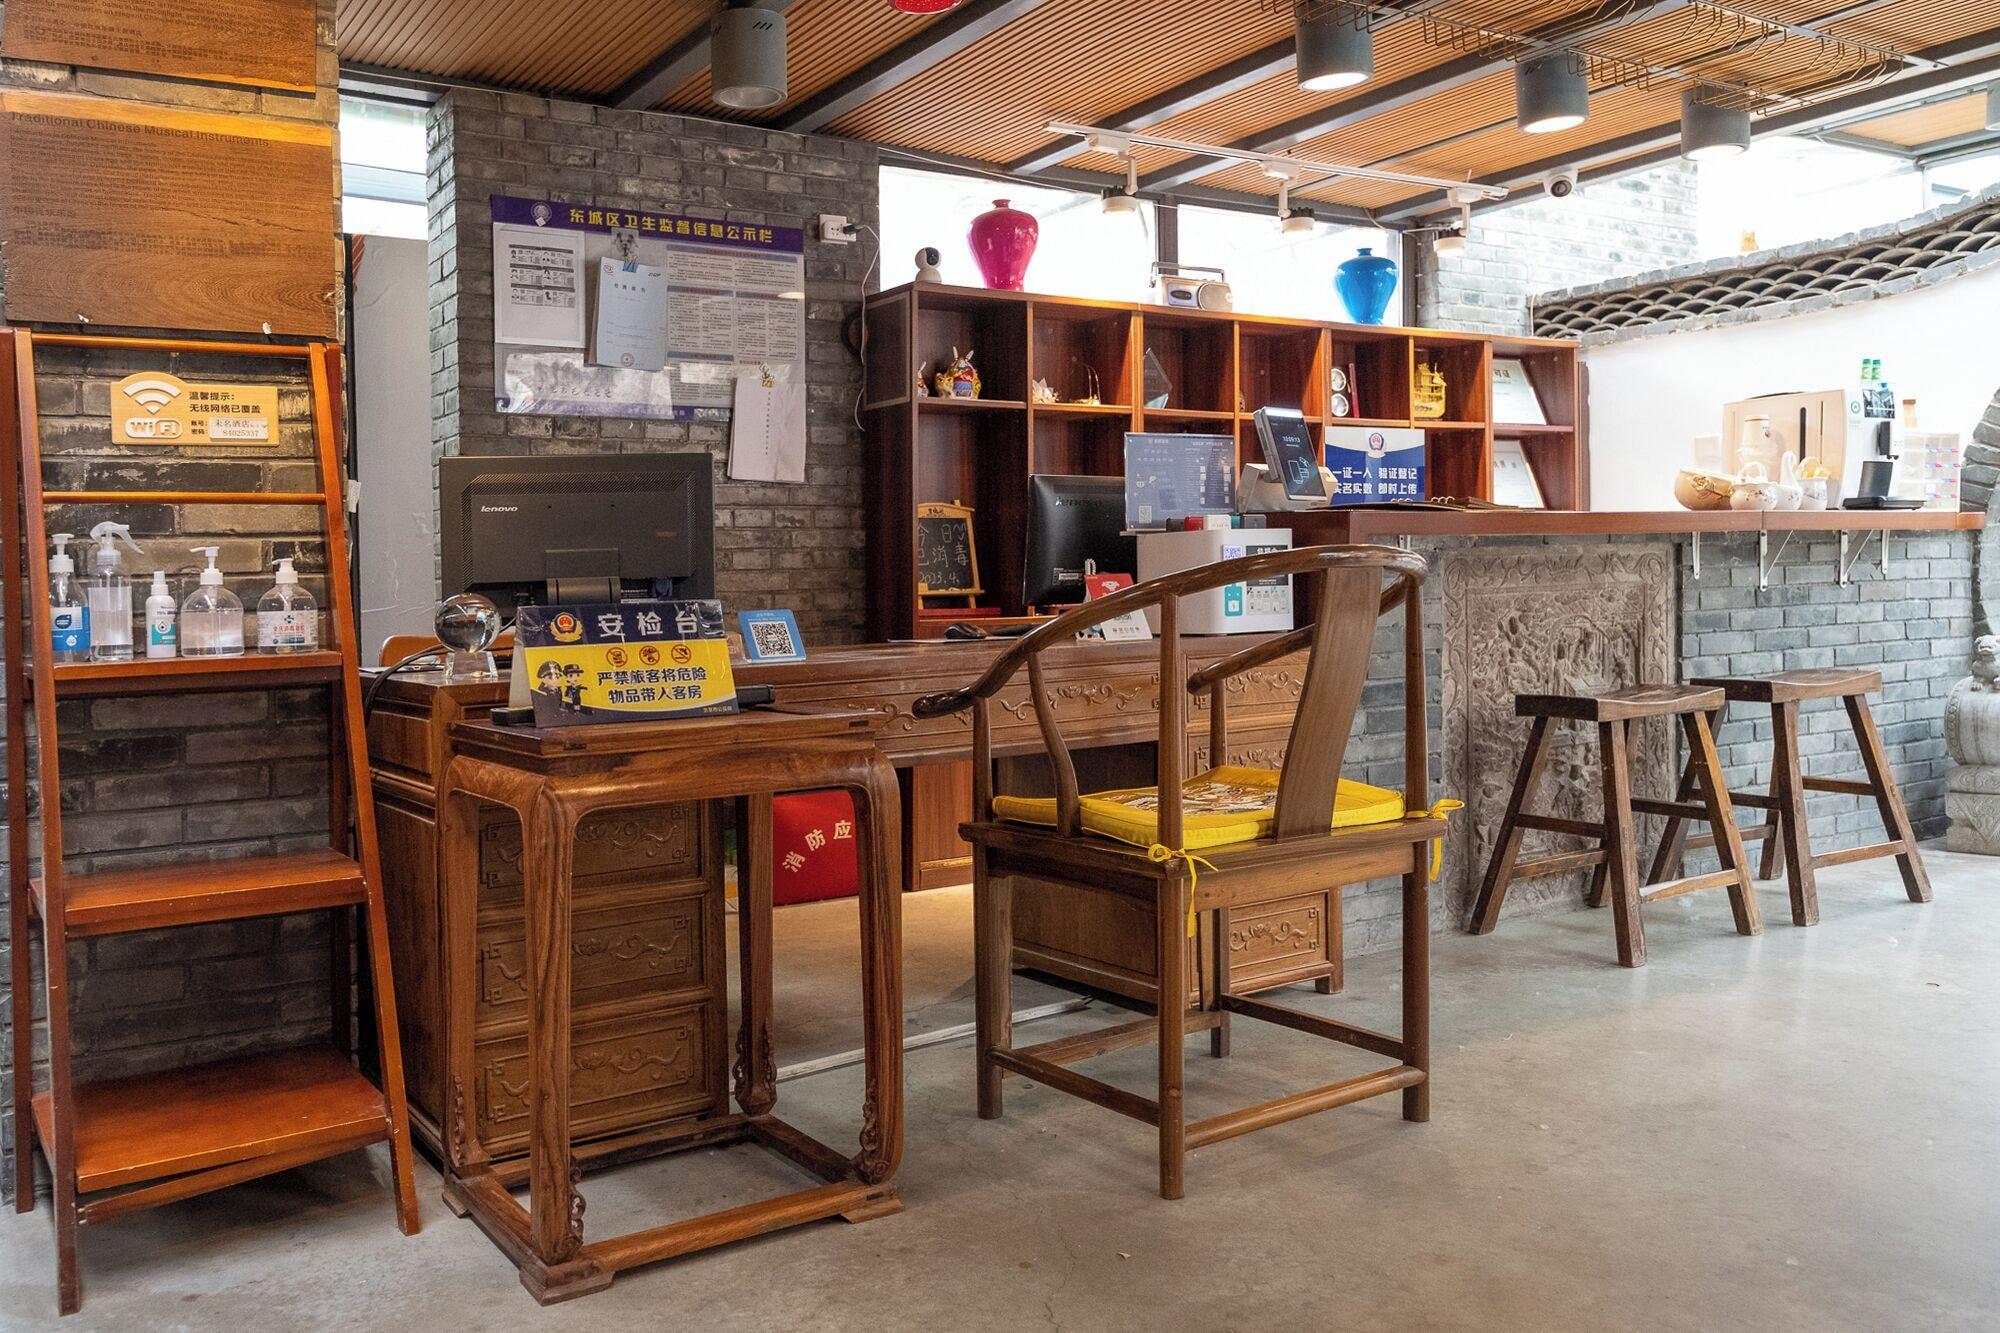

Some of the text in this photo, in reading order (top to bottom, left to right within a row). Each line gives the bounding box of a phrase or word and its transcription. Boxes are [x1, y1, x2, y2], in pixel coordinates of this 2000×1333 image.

[10, 112, 270, 147] Traditional Chinese Musical Instruments
[569, 208, 773, 244] 东城区卫生监督信息公示栏
[189, 404, 261, 414] 无线网络已覆盖
[1332, 467, 1418, 480] 一证一人 验证登记
[480, 505, 519, 513] lenovo
[598, 610, 698, 638] 安检台
[597, 667, 707, 686] 严禁旅客将危险
[608, 685, 702, 704] 物品带入客房
[782, 820, 853, 873] 消防应
